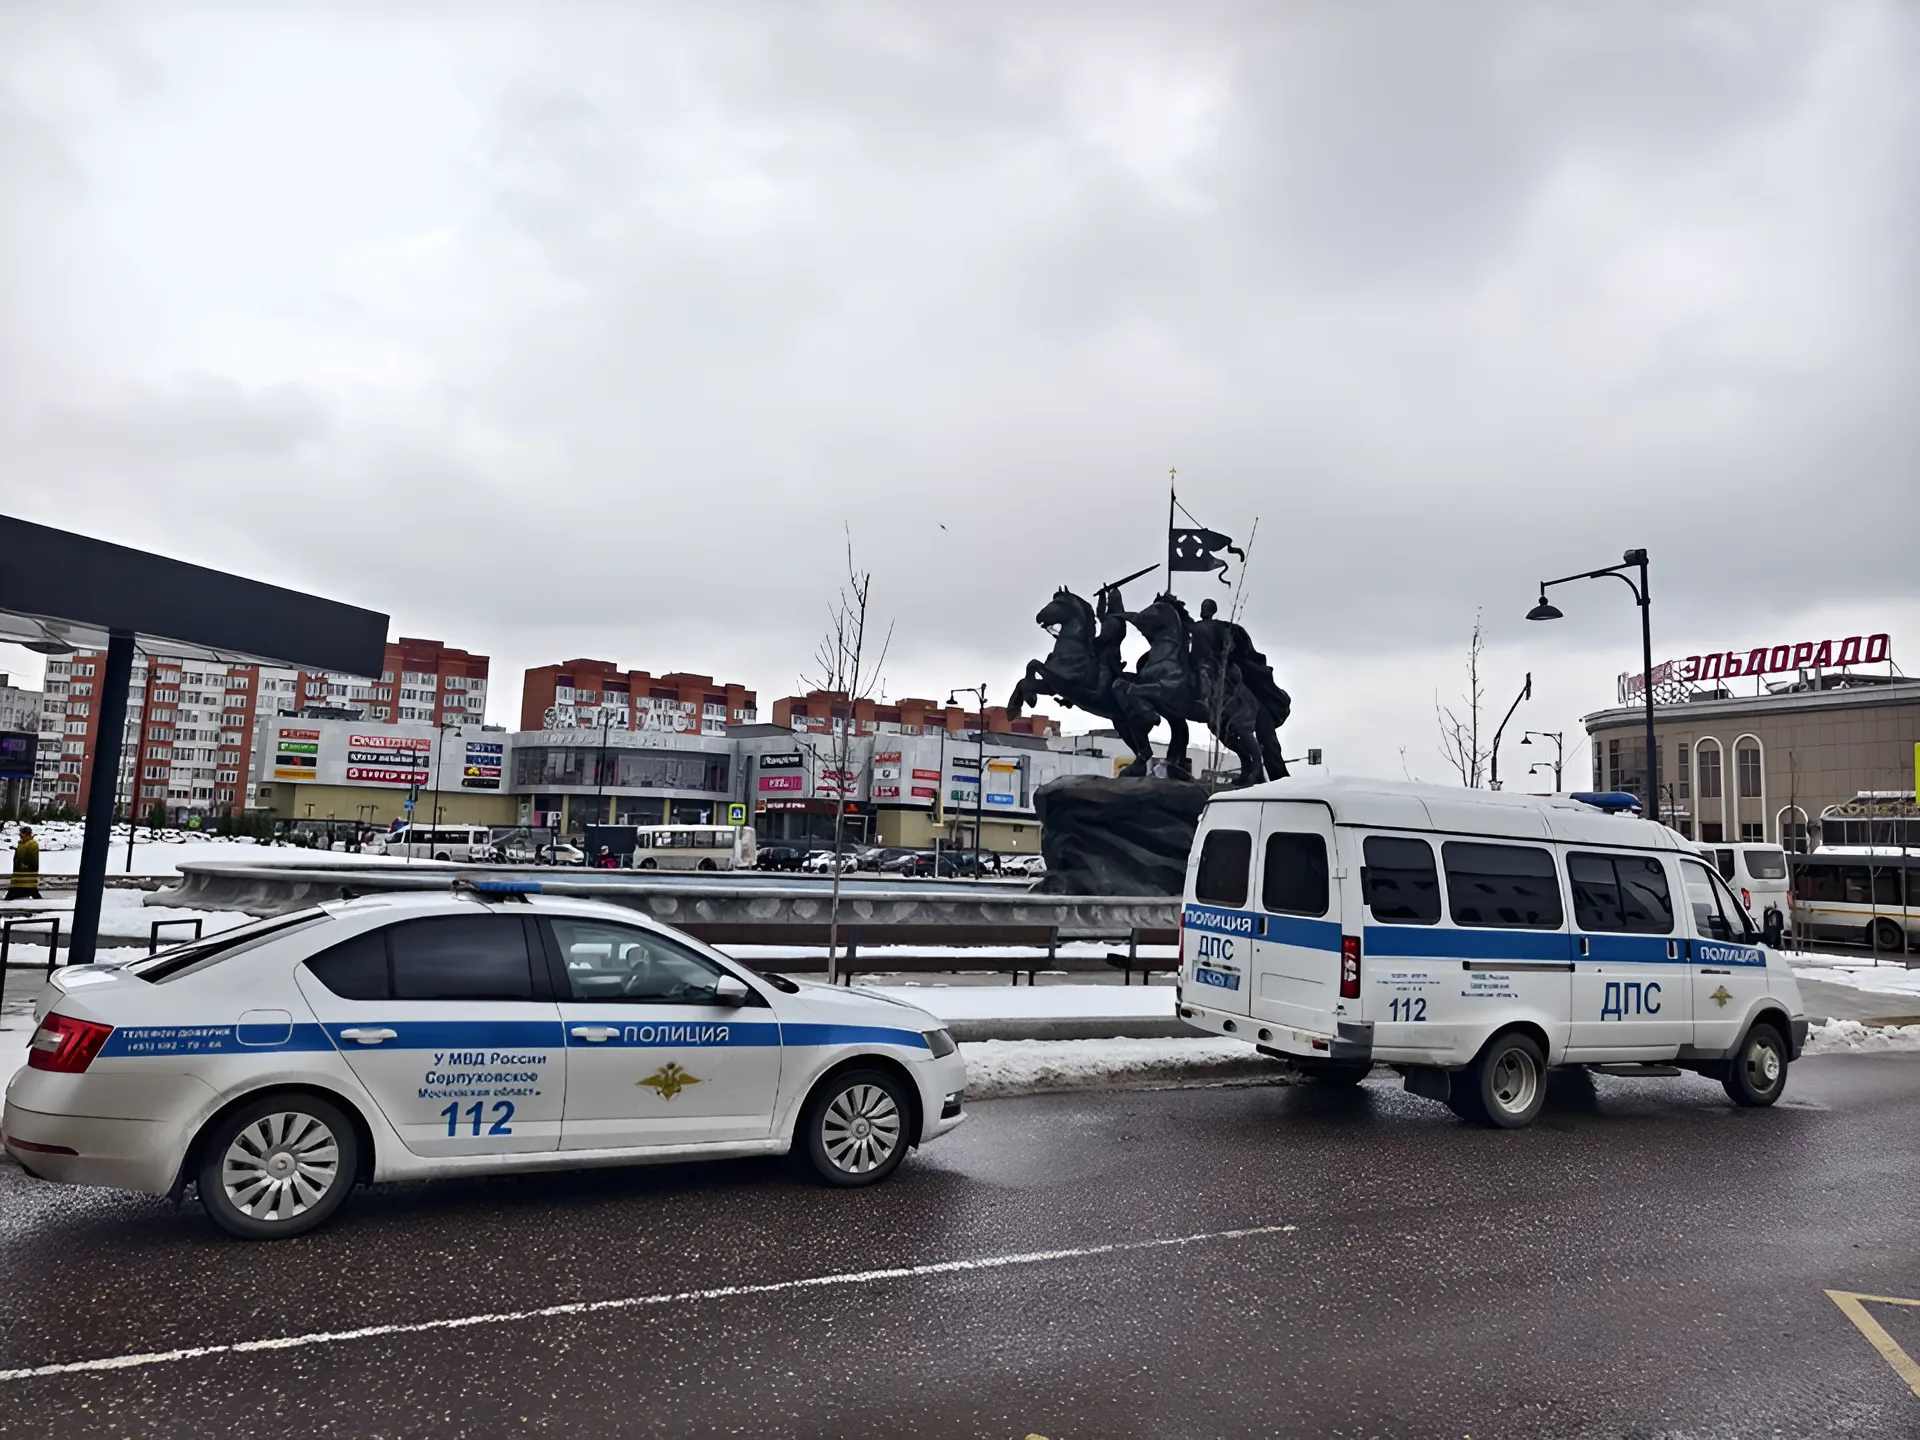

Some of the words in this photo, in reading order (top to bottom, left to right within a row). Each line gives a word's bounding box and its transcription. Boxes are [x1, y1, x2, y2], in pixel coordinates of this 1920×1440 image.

[1683, 633, 1889, 682] ЭЛЬДОРАДО
[1185, 909, 1252, 932] ПОЛИЦИЯ
[1198, 935, 1234, 962] ДПС
[1700, 946, 1760, 964] ПОЛИЦИЯ
[1389, 997, 1427, 1022] 112
[1601, 982, 1662, 1022] ДПС
[623, 1025, 730, 1044] ПОЛИЦИЯ
[490, 1051, 547, 1065] России
[440, 1100, 515, 1137] 112
